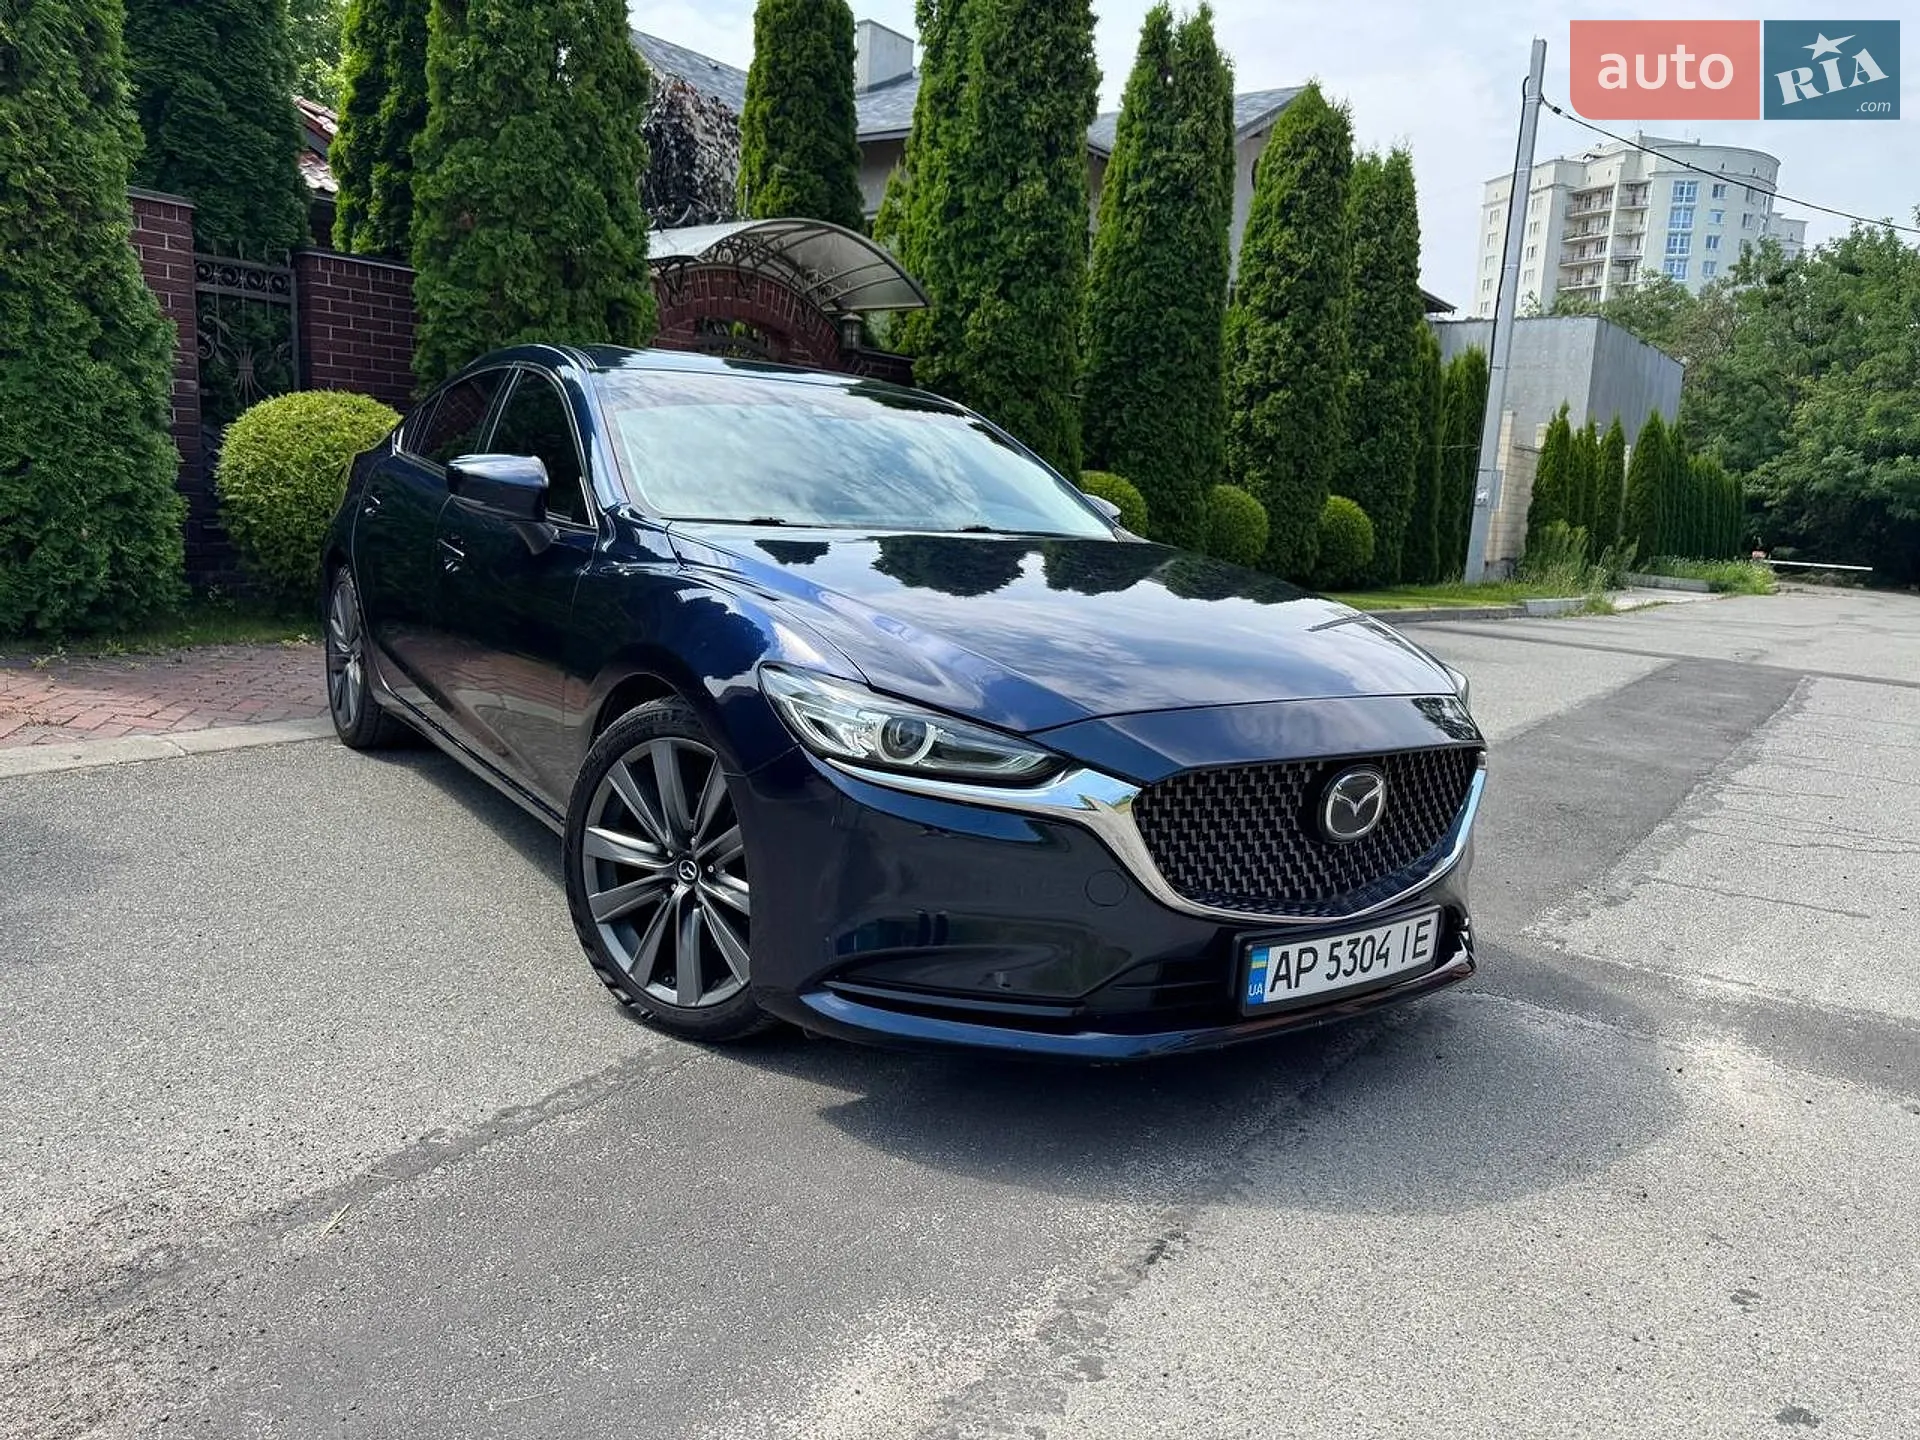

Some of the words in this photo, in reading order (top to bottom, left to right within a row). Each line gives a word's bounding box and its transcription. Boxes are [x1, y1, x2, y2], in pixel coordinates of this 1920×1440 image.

[1269, 946, 1318, 992] AP
[1326, 930, 1391, 981] 5304
[1401, 919, 1432, 963] IE
[1248, 984, 1263, 996] UA
